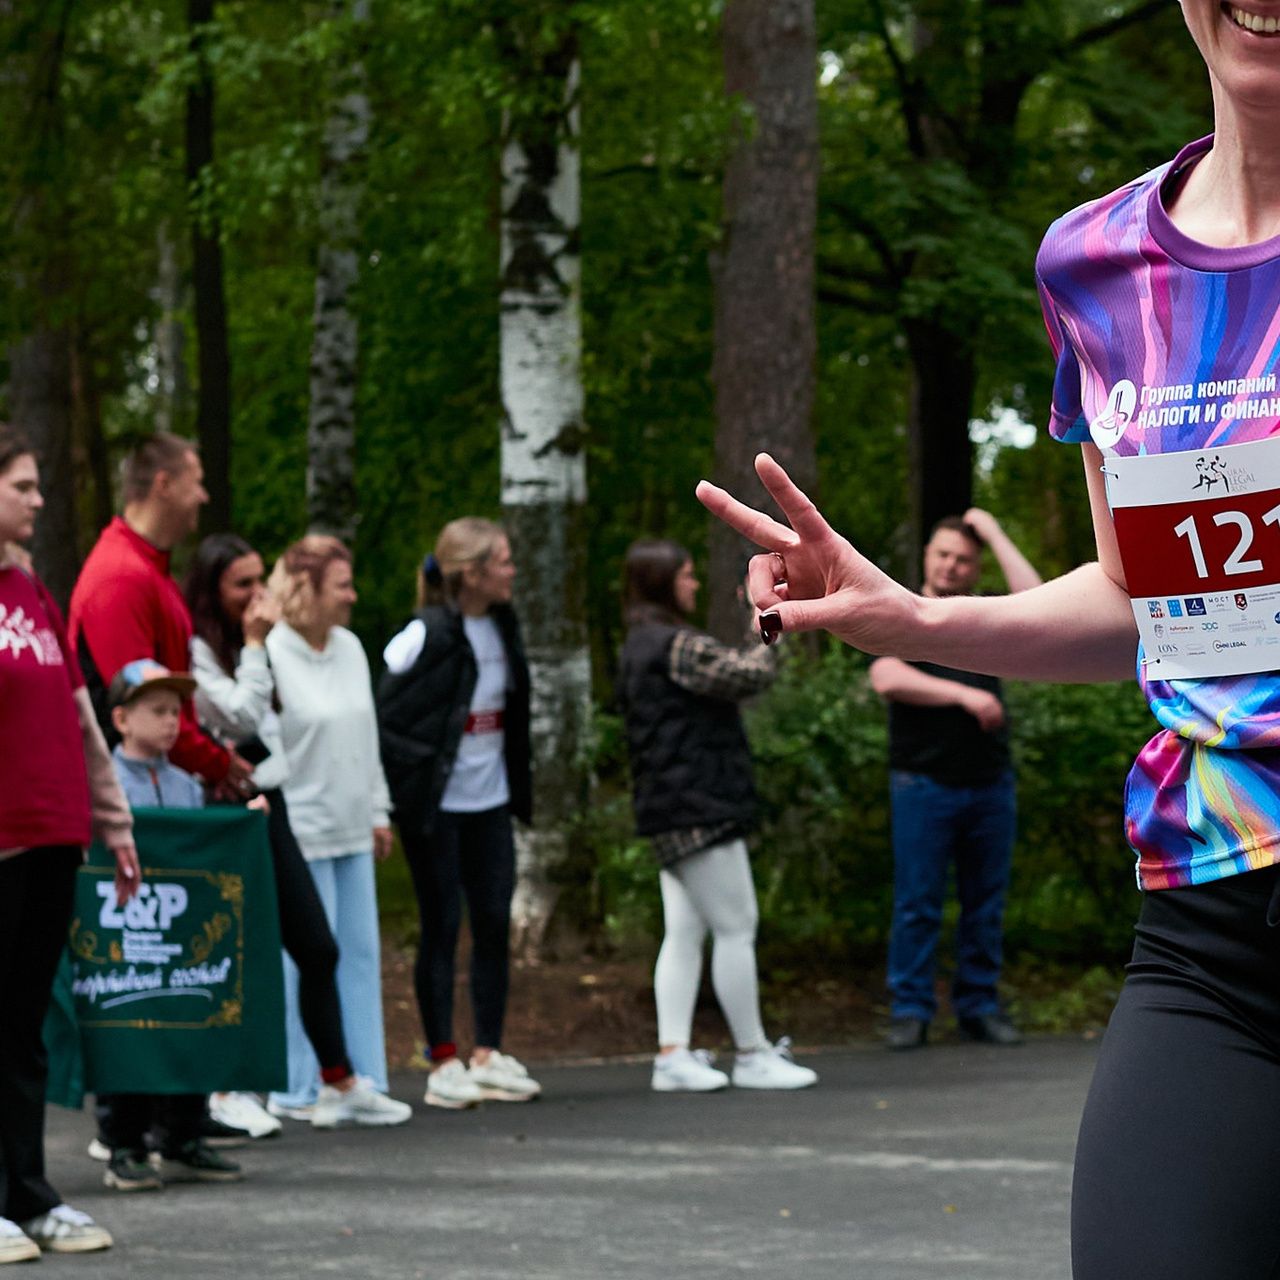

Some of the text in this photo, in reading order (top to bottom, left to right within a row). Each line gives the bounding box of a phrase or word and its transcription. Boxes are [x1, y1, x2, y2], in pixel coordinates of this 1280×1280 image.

[1140, 373, 1276, 407] Группа компаний
[1137, 401, 1202, 431] НАЛОГИ
[1203, 401, 1217, 423] И
[1229, 473, 1257, 486] LEGAL
[96, 880, 188, 931] Z&P
